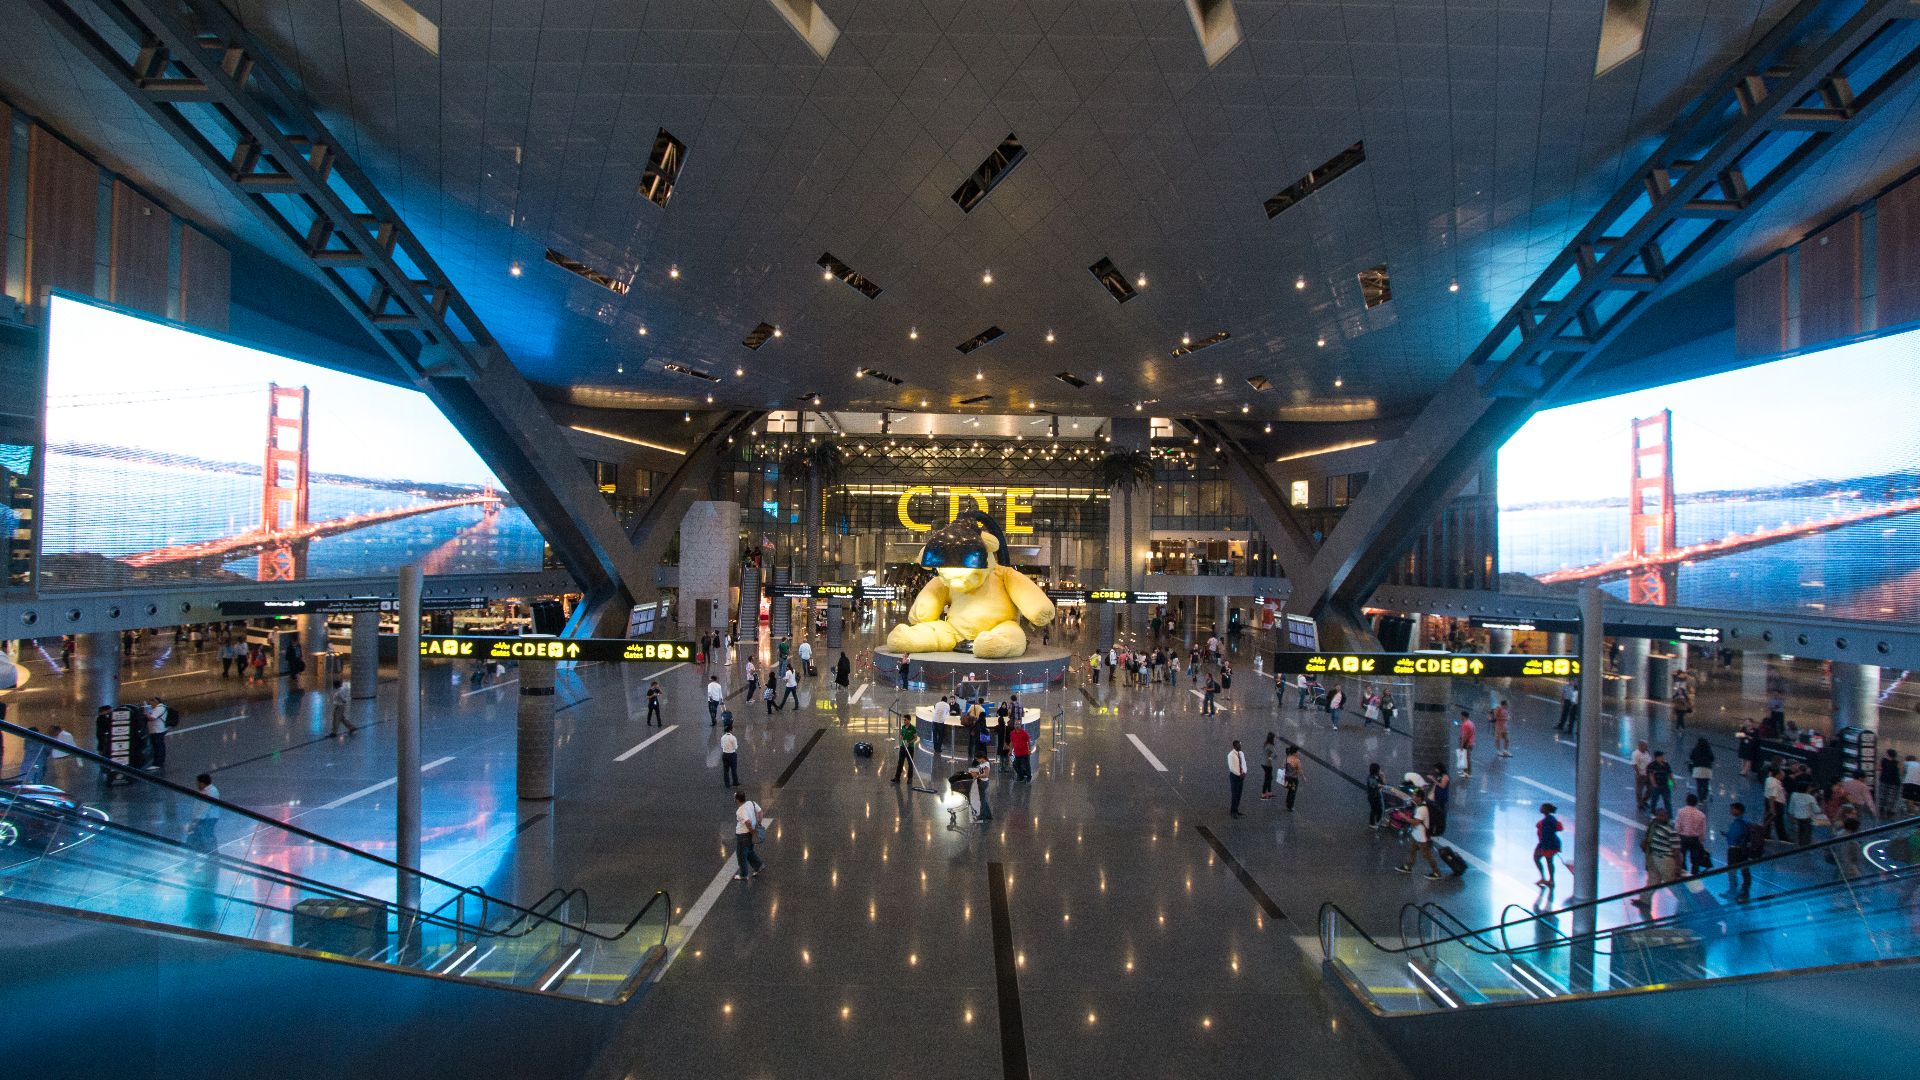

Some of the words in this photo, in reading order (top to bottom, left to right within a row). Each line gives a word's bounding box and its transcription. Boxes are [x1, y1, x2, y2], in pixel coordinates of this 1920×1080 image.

[428, 640, 442, 654] A
[490, 649, 511, 657] Gates
[511, 642, 547, 656] CDE
[623, 651, 644, 659] Gates
[645, 644, 655, 658] B
[1305, 663, 1326, 672] Gates
[1327, 657, 1341, 671] A
[1393, 665, 1415, 674] Gates
[1415, 658, 1451, 673] CDE
[1542, 660, 1554, 674] B
